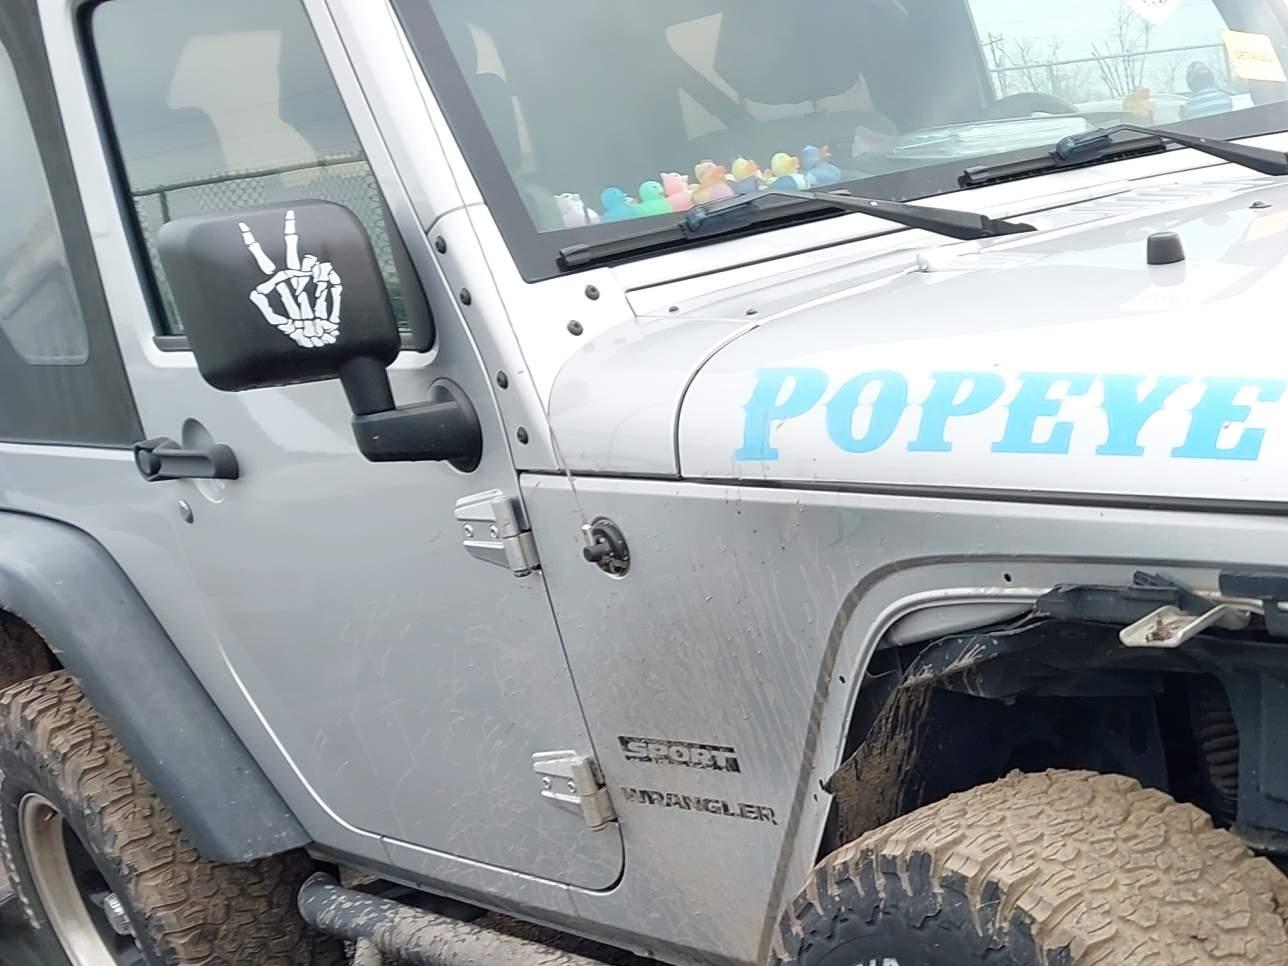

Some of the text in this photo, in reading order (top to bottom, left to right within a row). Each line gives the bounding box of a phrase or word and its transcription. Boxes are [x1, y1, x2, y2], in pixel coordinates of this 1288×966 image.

[734, 366, 1288, 461] POPEYE
[622, 738, 739, 772] SPORT
[620, 786, 779, 826] WRANGLER
